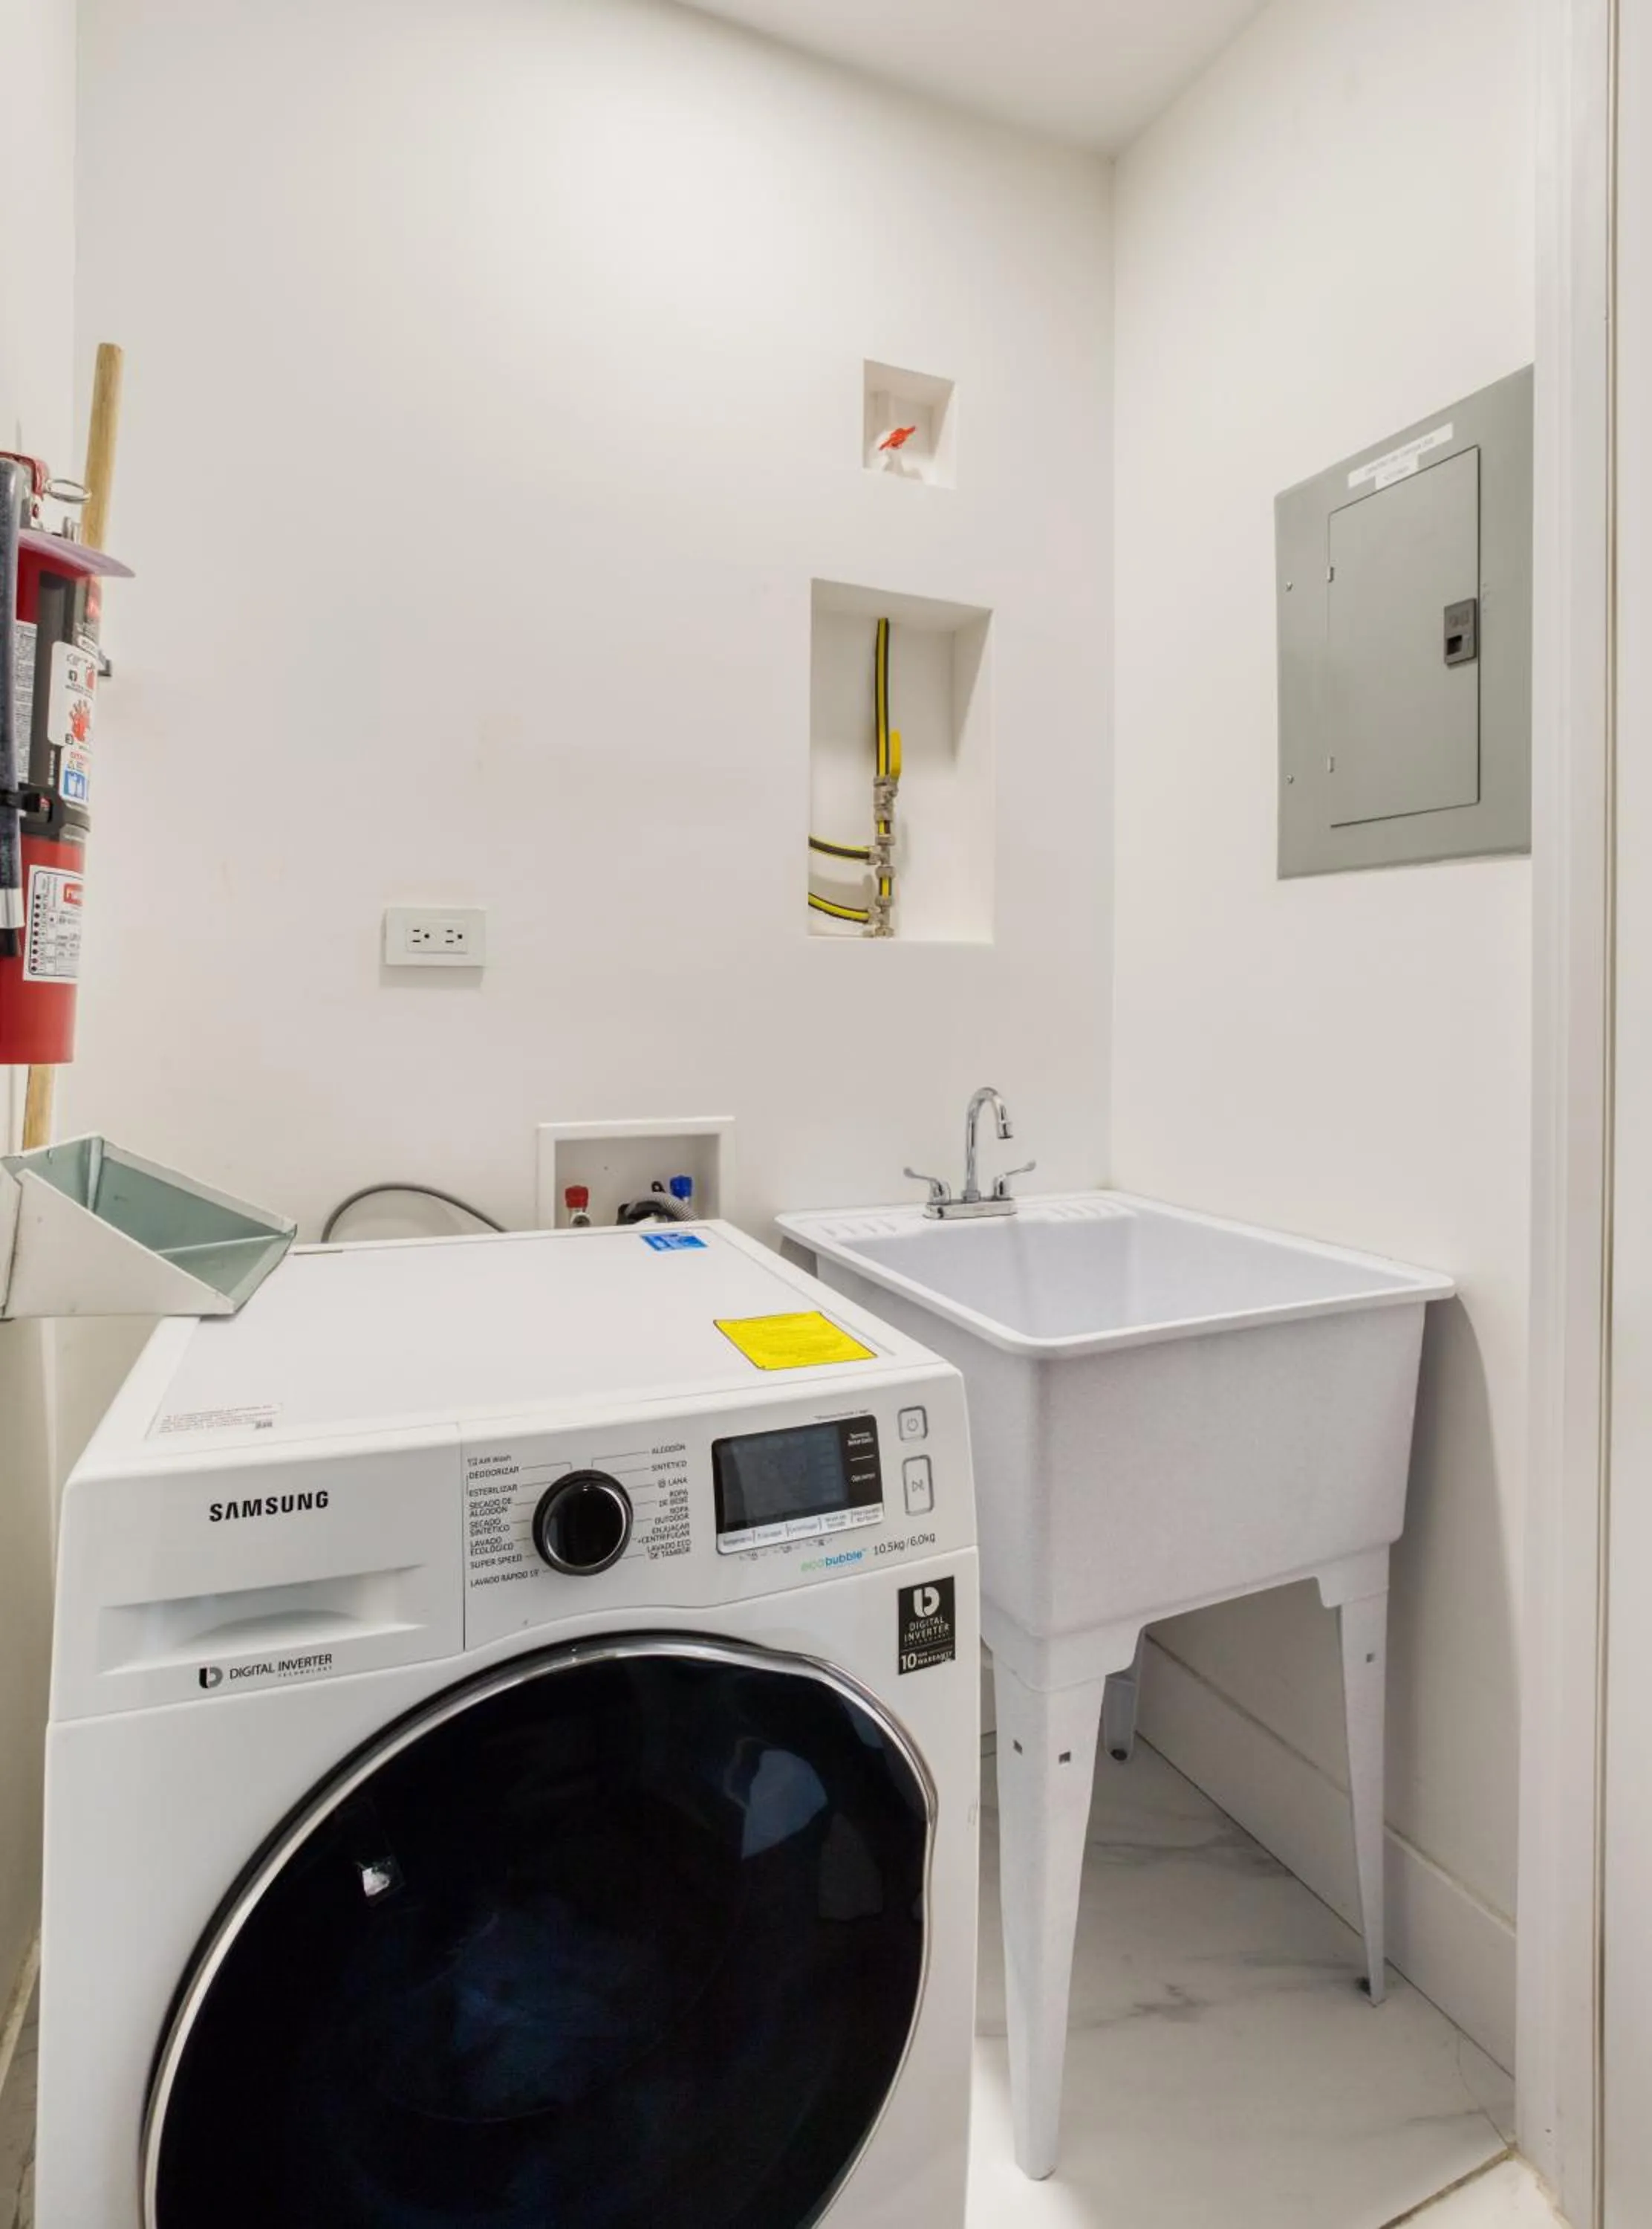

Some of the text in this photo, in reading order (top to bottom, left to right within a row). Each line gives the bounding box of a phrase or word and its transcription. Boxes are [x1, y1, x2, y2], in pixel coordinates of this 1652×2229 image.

[209, 1490, 329, 1522] SAMSUNG
[904, 1623, 951, 1643] INVERTER
[908, 1616, 945, 1631] DIGITAL
[230, 1662, 274, 1679] DIGITAL
[278, 1653, 333, 1671] INVERTER
[901, 1652, 917, 1670] 10
